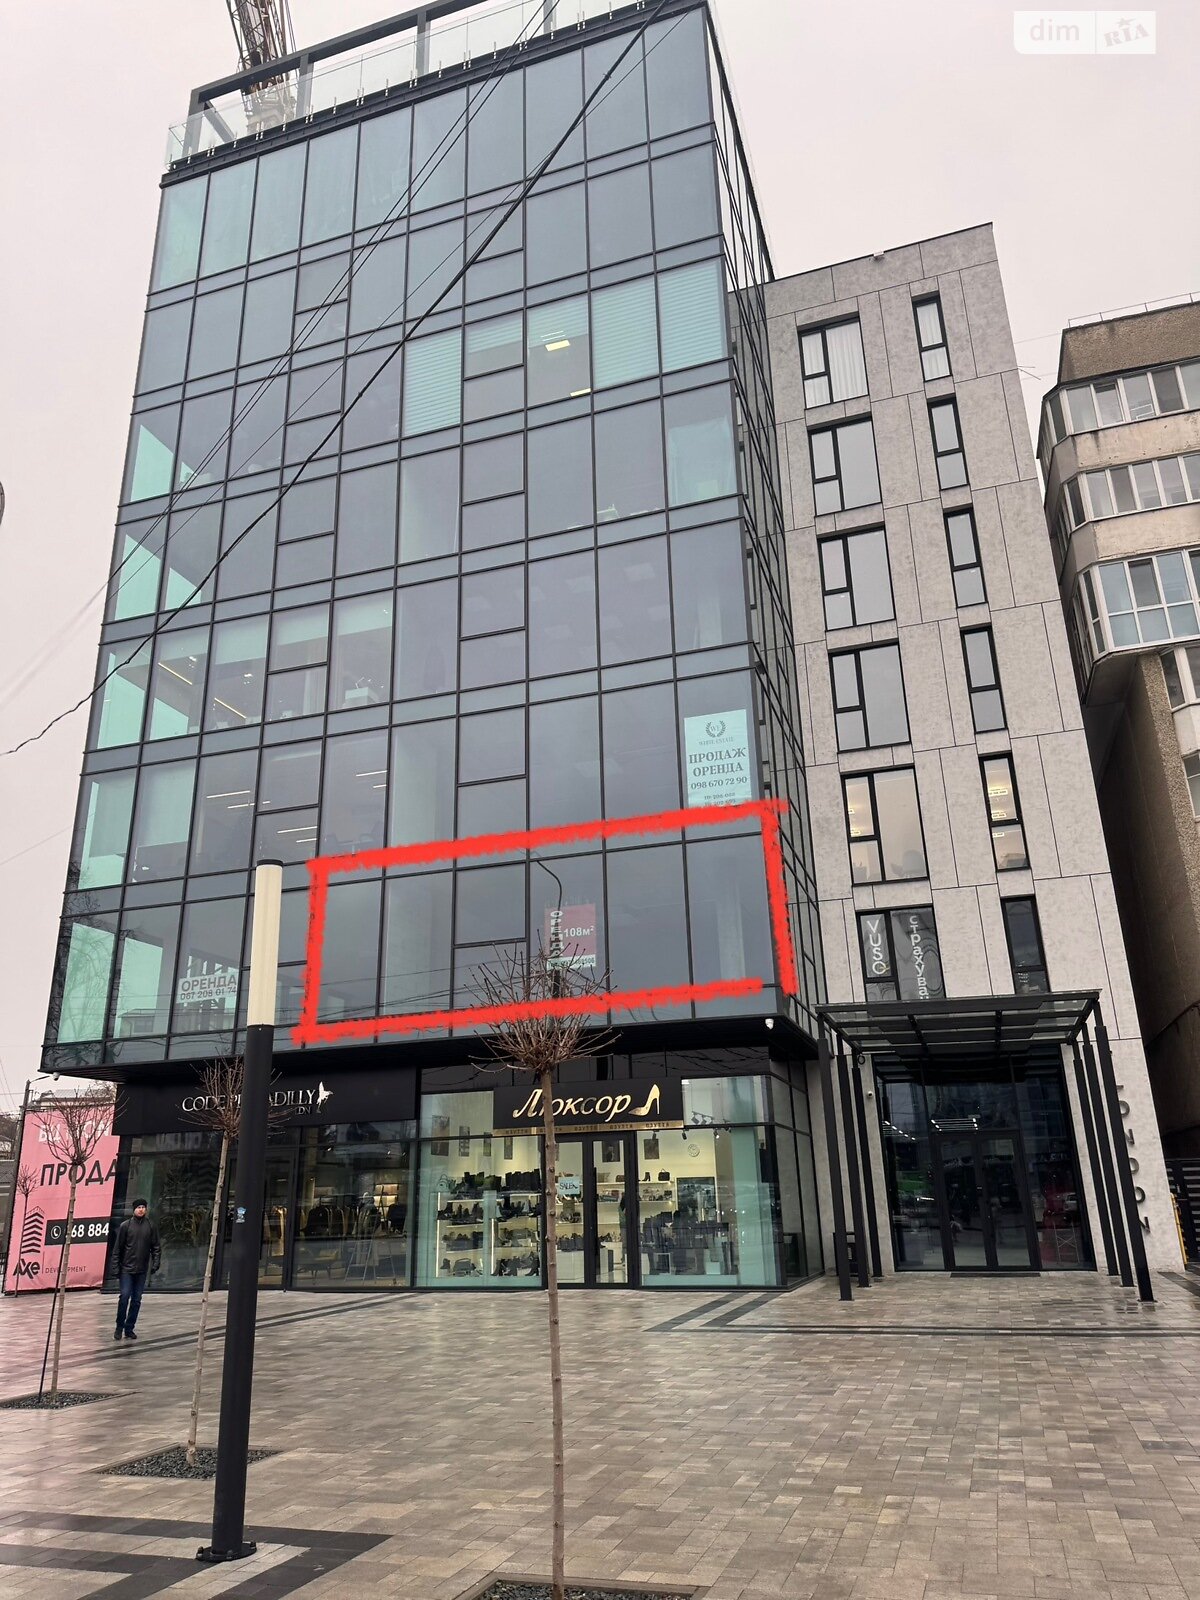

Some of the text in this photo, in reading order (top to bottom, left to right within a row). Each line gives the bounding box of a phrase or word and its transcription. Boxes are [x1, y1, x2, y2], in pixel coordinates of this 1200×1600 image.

[689, 747, 746, 764] ПРОДАЖ
[693, 762, 744, 777] ОРЕНДА
[690, 781, 708, 790] 098
[708, 779, 724, 788] 670
[736, 776, 748, 784] 90
[867, 919, 890, 975] VUSO
[909, 915, 930, 999] страхува
[181, 974, 237, 992] ОРЕНДА
[512, 1088, 632, 1122] Люксор
[66, 1222, 110, 1239] 68 884
